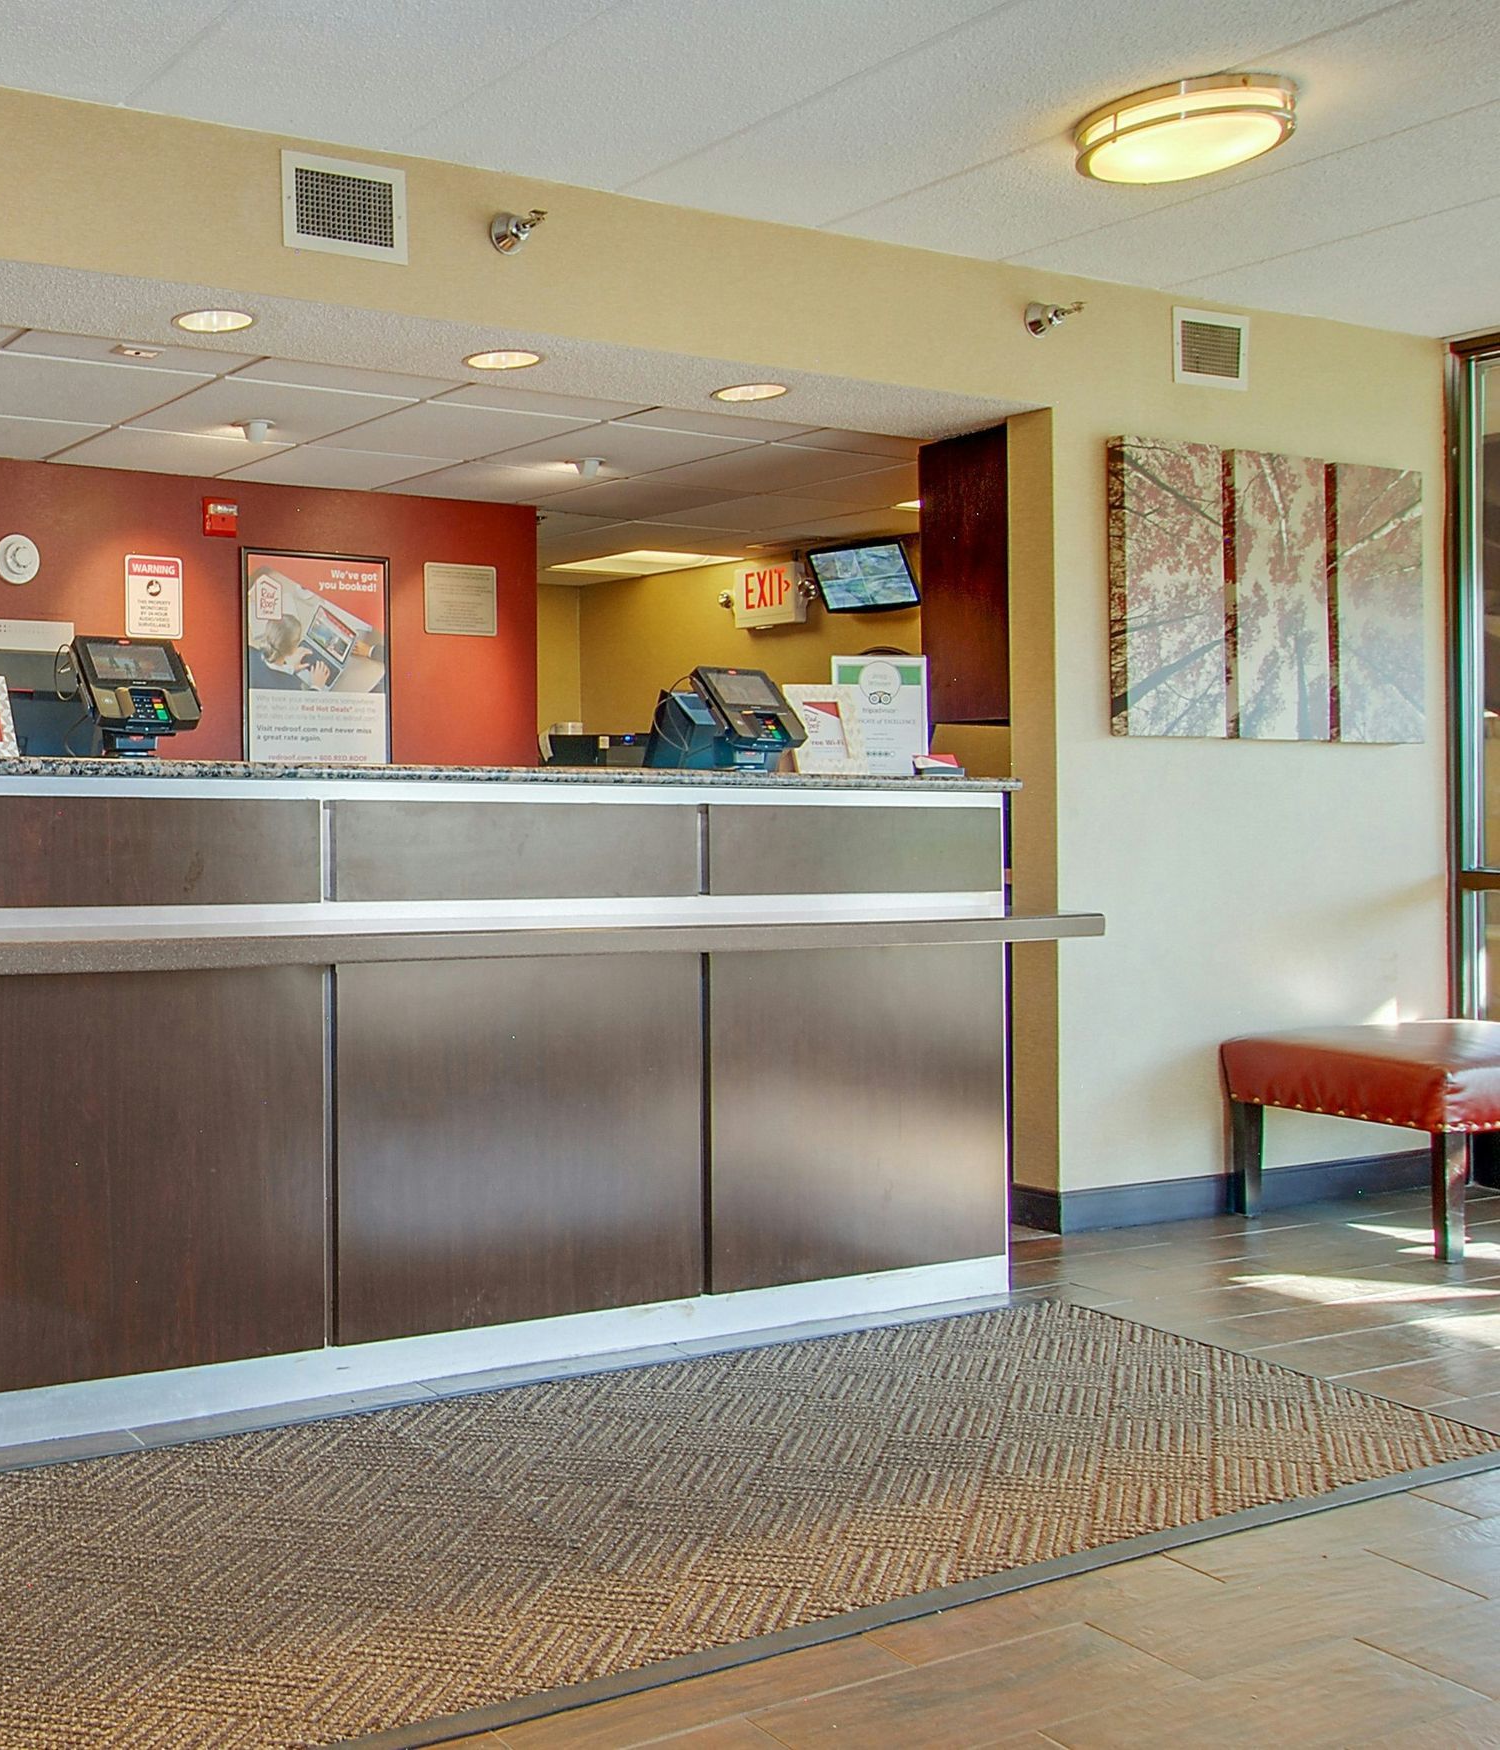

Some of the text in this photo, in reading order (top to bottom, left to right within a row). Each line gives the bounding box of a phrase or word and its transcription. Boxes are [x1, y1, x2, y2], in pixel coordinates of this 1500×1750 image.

[131, 562, 176, 575] WARNING
[330, 569, 378, 583] We've got
[319, 580, 378, 593] you booked!
[745, 567, 787, 610] EXIT
[260, 588, 276, 600] Red
[301, 704, 315, 712] Red
[315, 705, 329, 713] Hot
[256, 724, 273, 732] Visit
[274, 725, 318, 733] redroof.com
[263, 734, 282, 742] great
